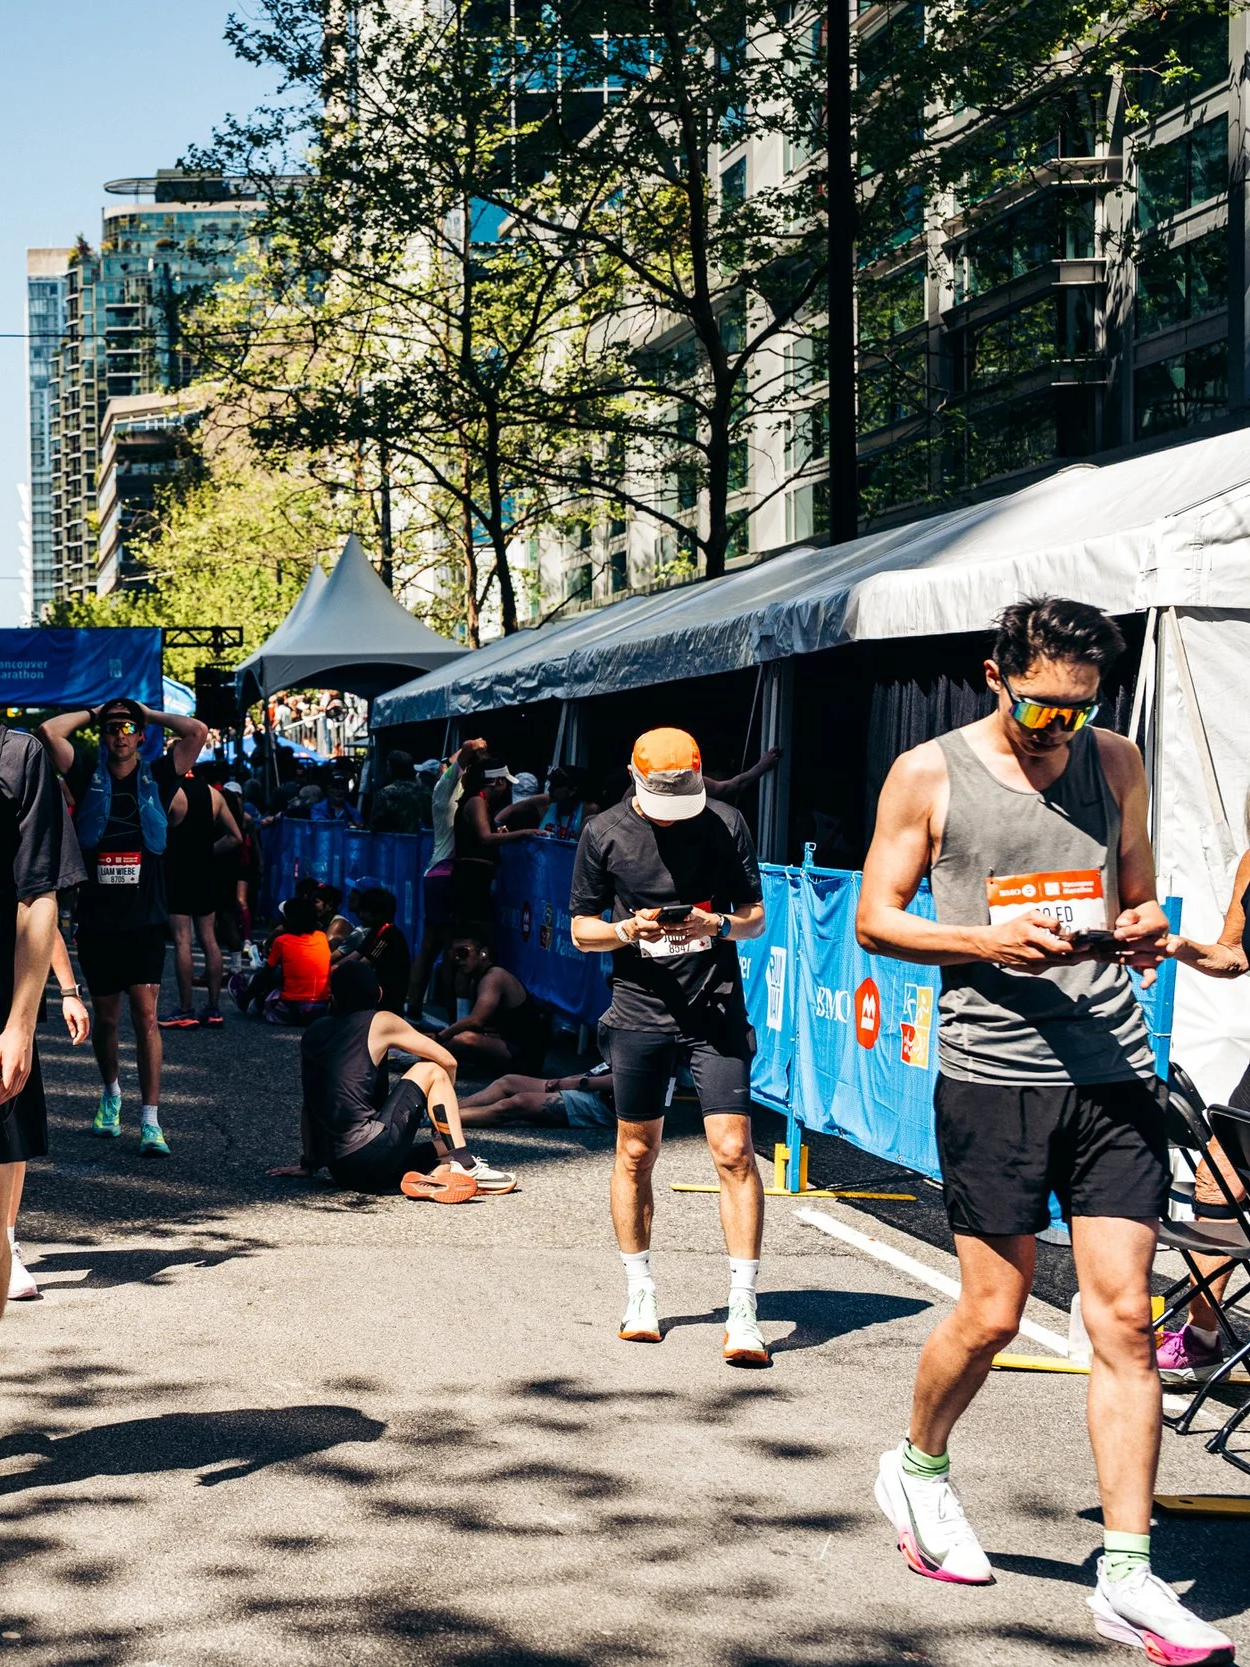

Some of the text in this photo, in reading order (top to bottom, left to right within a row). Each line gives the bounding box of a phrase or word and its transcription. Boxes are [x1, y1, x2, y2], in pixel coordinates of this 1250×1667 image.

[101, 867, 136, 875] LIAM WIEBE
[1056, 906, 1074, 923] ED
[815, 985, 852, 1024] BMO
